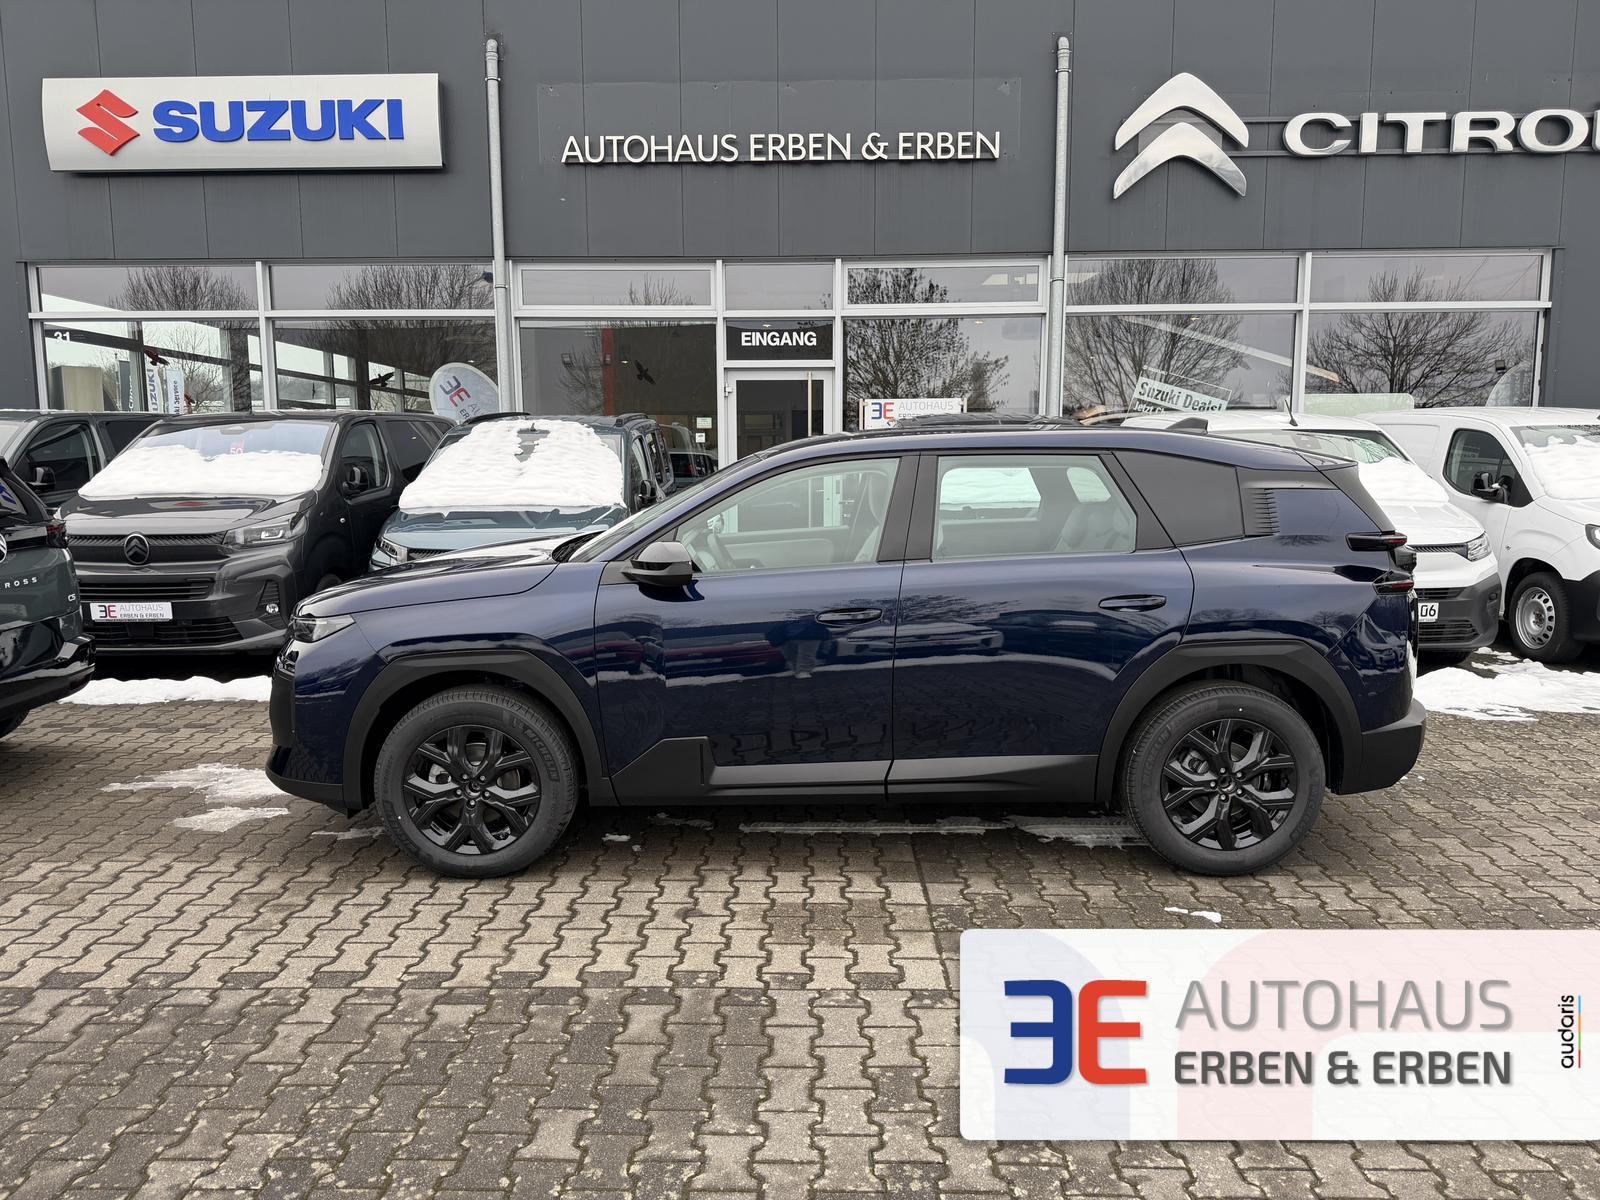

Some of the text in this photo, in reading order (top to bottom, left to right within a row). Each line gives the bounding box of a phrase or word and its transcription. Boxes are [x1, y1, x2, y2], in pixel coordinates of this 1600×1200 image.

[153, 98, 404, 143] SUZUKI
[1283, 108, 1600, 156] CITRO
[561, 130, 1001, 164] AUTOHAUS ERBEN & ERBEN
[54, 331, 71, 343] 31
[741, 331, 817, 347] EINGANG
[147, 368, 159, 412] UZUKI
[1138, 381, 1182, 406] Suzuki
[898, 401, 954, 411] AUTOHAUS
[4, 576, 38, 589] ROSS
[120, 603, 164, 611] AUTOHAUS
